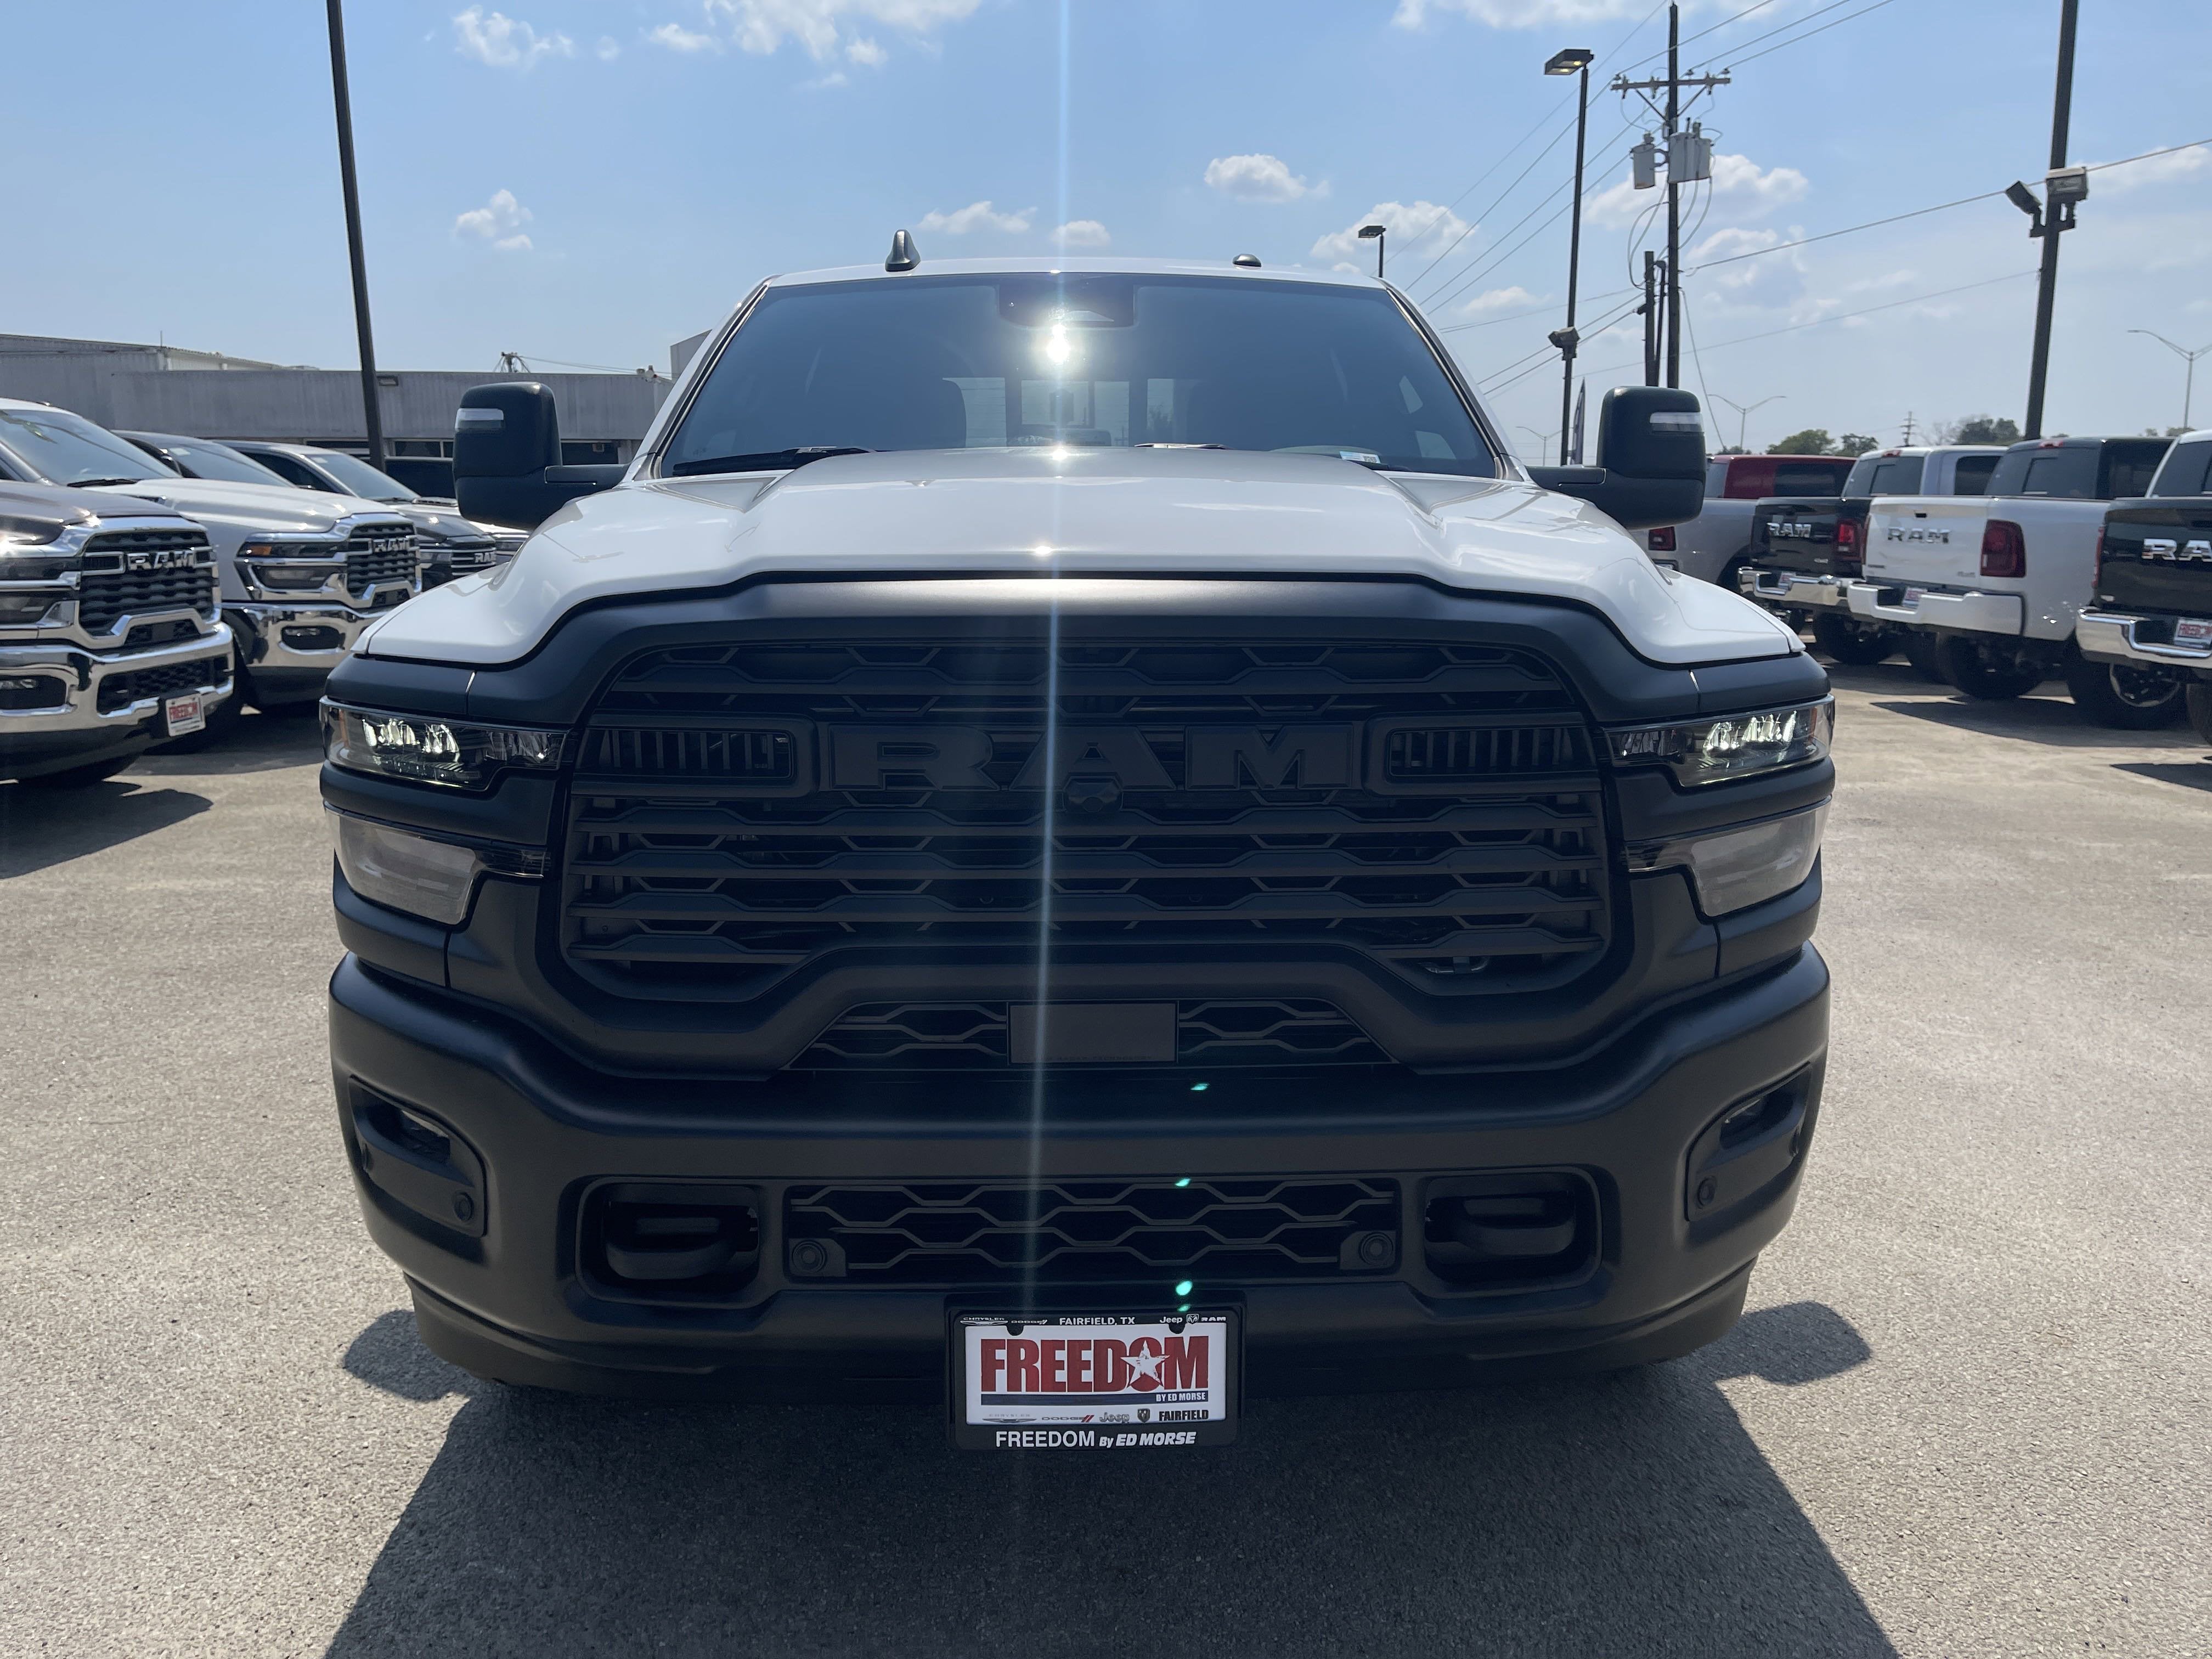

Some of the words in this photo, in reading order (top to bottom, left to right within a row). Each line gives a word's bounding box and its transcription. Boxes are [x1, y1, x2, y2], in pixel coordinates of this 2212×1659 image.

[1767, 522, 1812, 538] RAM
[1888, 527, 1951, 543] RAM
[2141, 538, 2212, 562] RA
[127, 550, 195, 571] RAM
[828, 725, 1355, 792] RAM
[1059, 1317, 1118, 1326] FAIRFIELD,
[1179, 1392, 1206, 1401] MORSE
[1099, 1412, 1130, 1424] Jeep
[1159, 1410, 1209, 1421] FAIRFIELD
[996, 1430, 1095, 1448] FREEDOM
[1099, 1436, 1114, 1448] By
[1116, 1434, 1137, 1447] ED
[1139, 1432, 1197, 1446] MORSE
